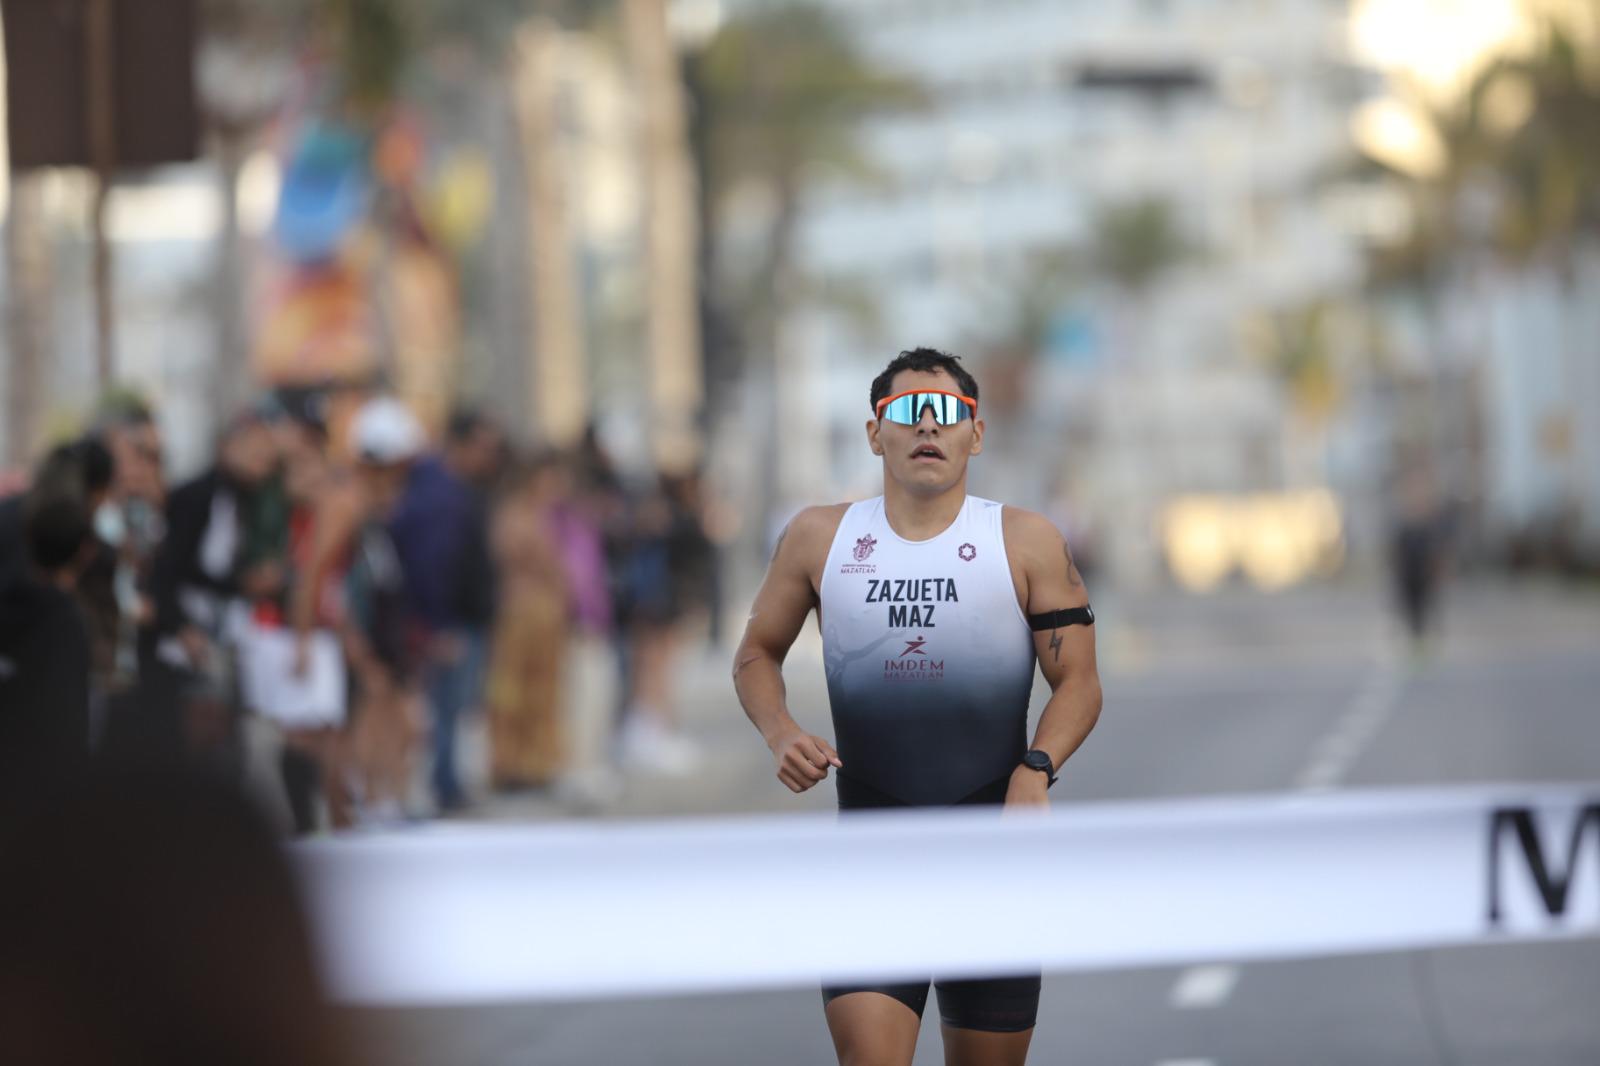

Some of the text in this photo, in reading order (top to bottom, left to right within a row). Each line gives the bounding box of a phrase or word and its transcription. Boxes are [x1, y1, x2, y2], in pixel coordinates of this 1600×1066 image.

[866, 578, 958, 602] ZAZUETA
[888, 605, 935, 628] MAZ
[884, 659, 944, 671] IMDEM
